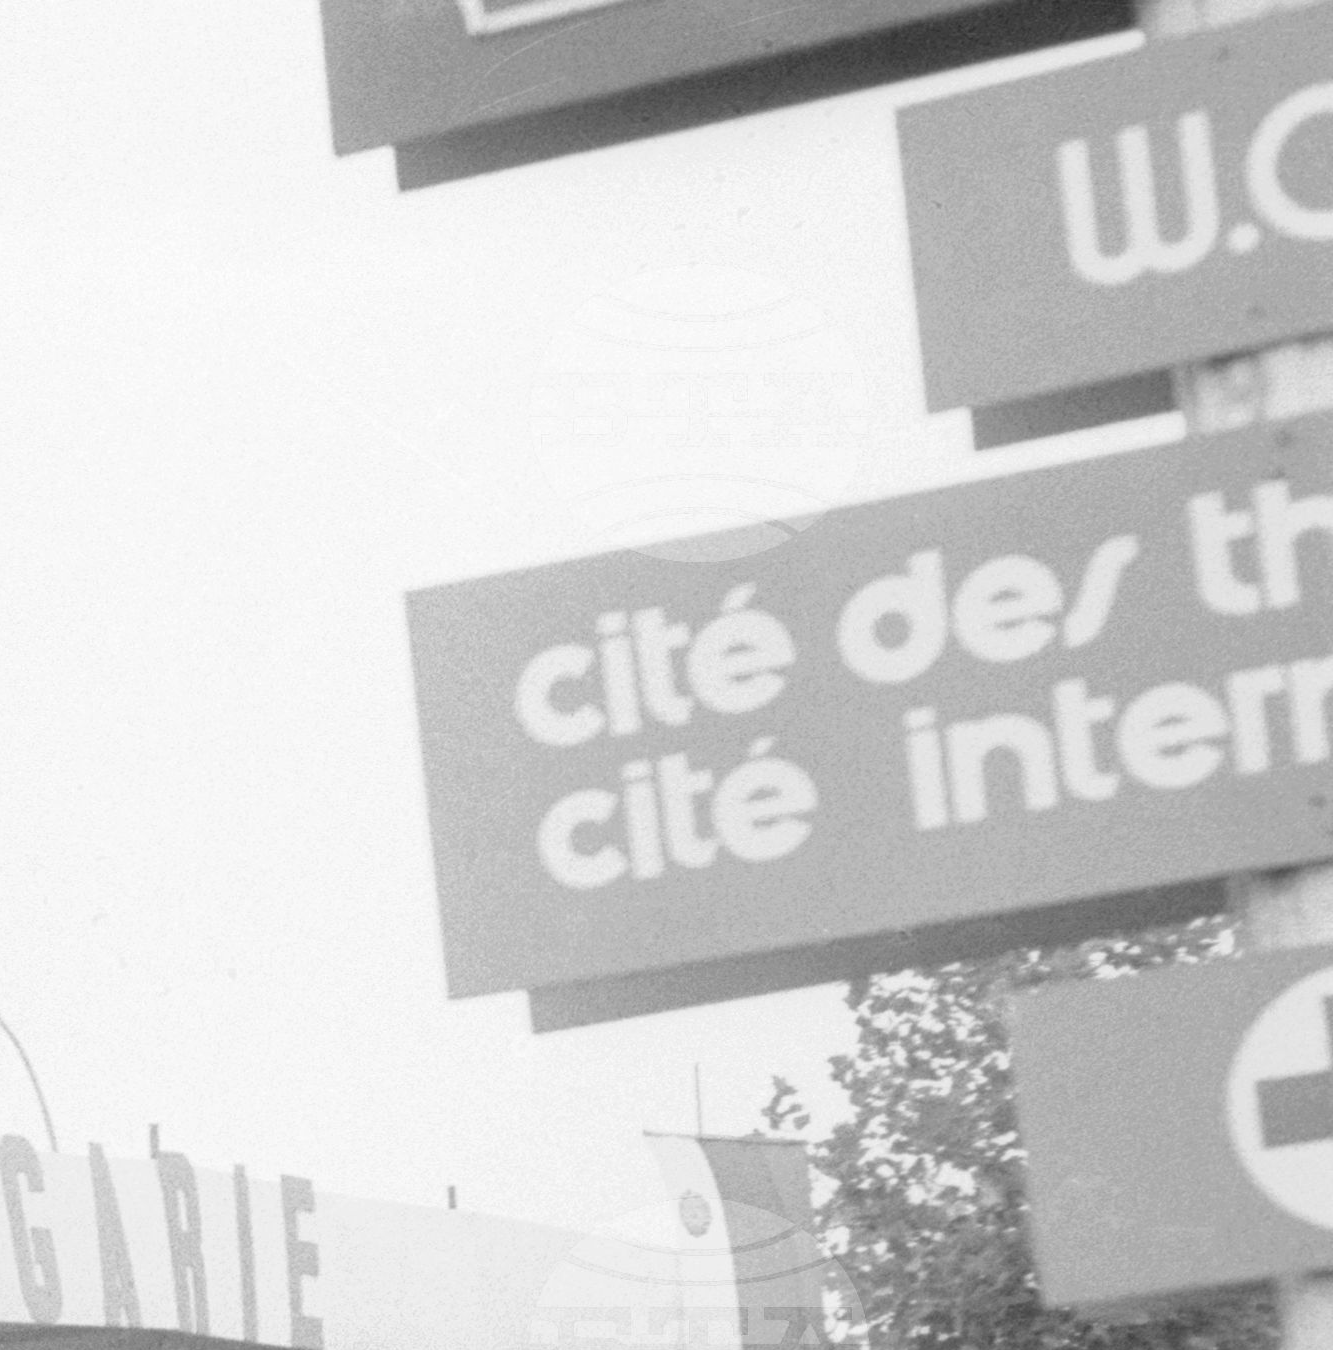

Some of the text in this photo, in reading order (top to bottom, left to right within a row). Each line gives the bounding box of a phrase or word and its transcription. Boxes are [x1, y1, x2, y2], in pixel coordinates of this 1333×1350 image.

[514, 582, 797, 747] cité
[836, 533, 1140, 684] des
[536, 736, 819, 890] cité
